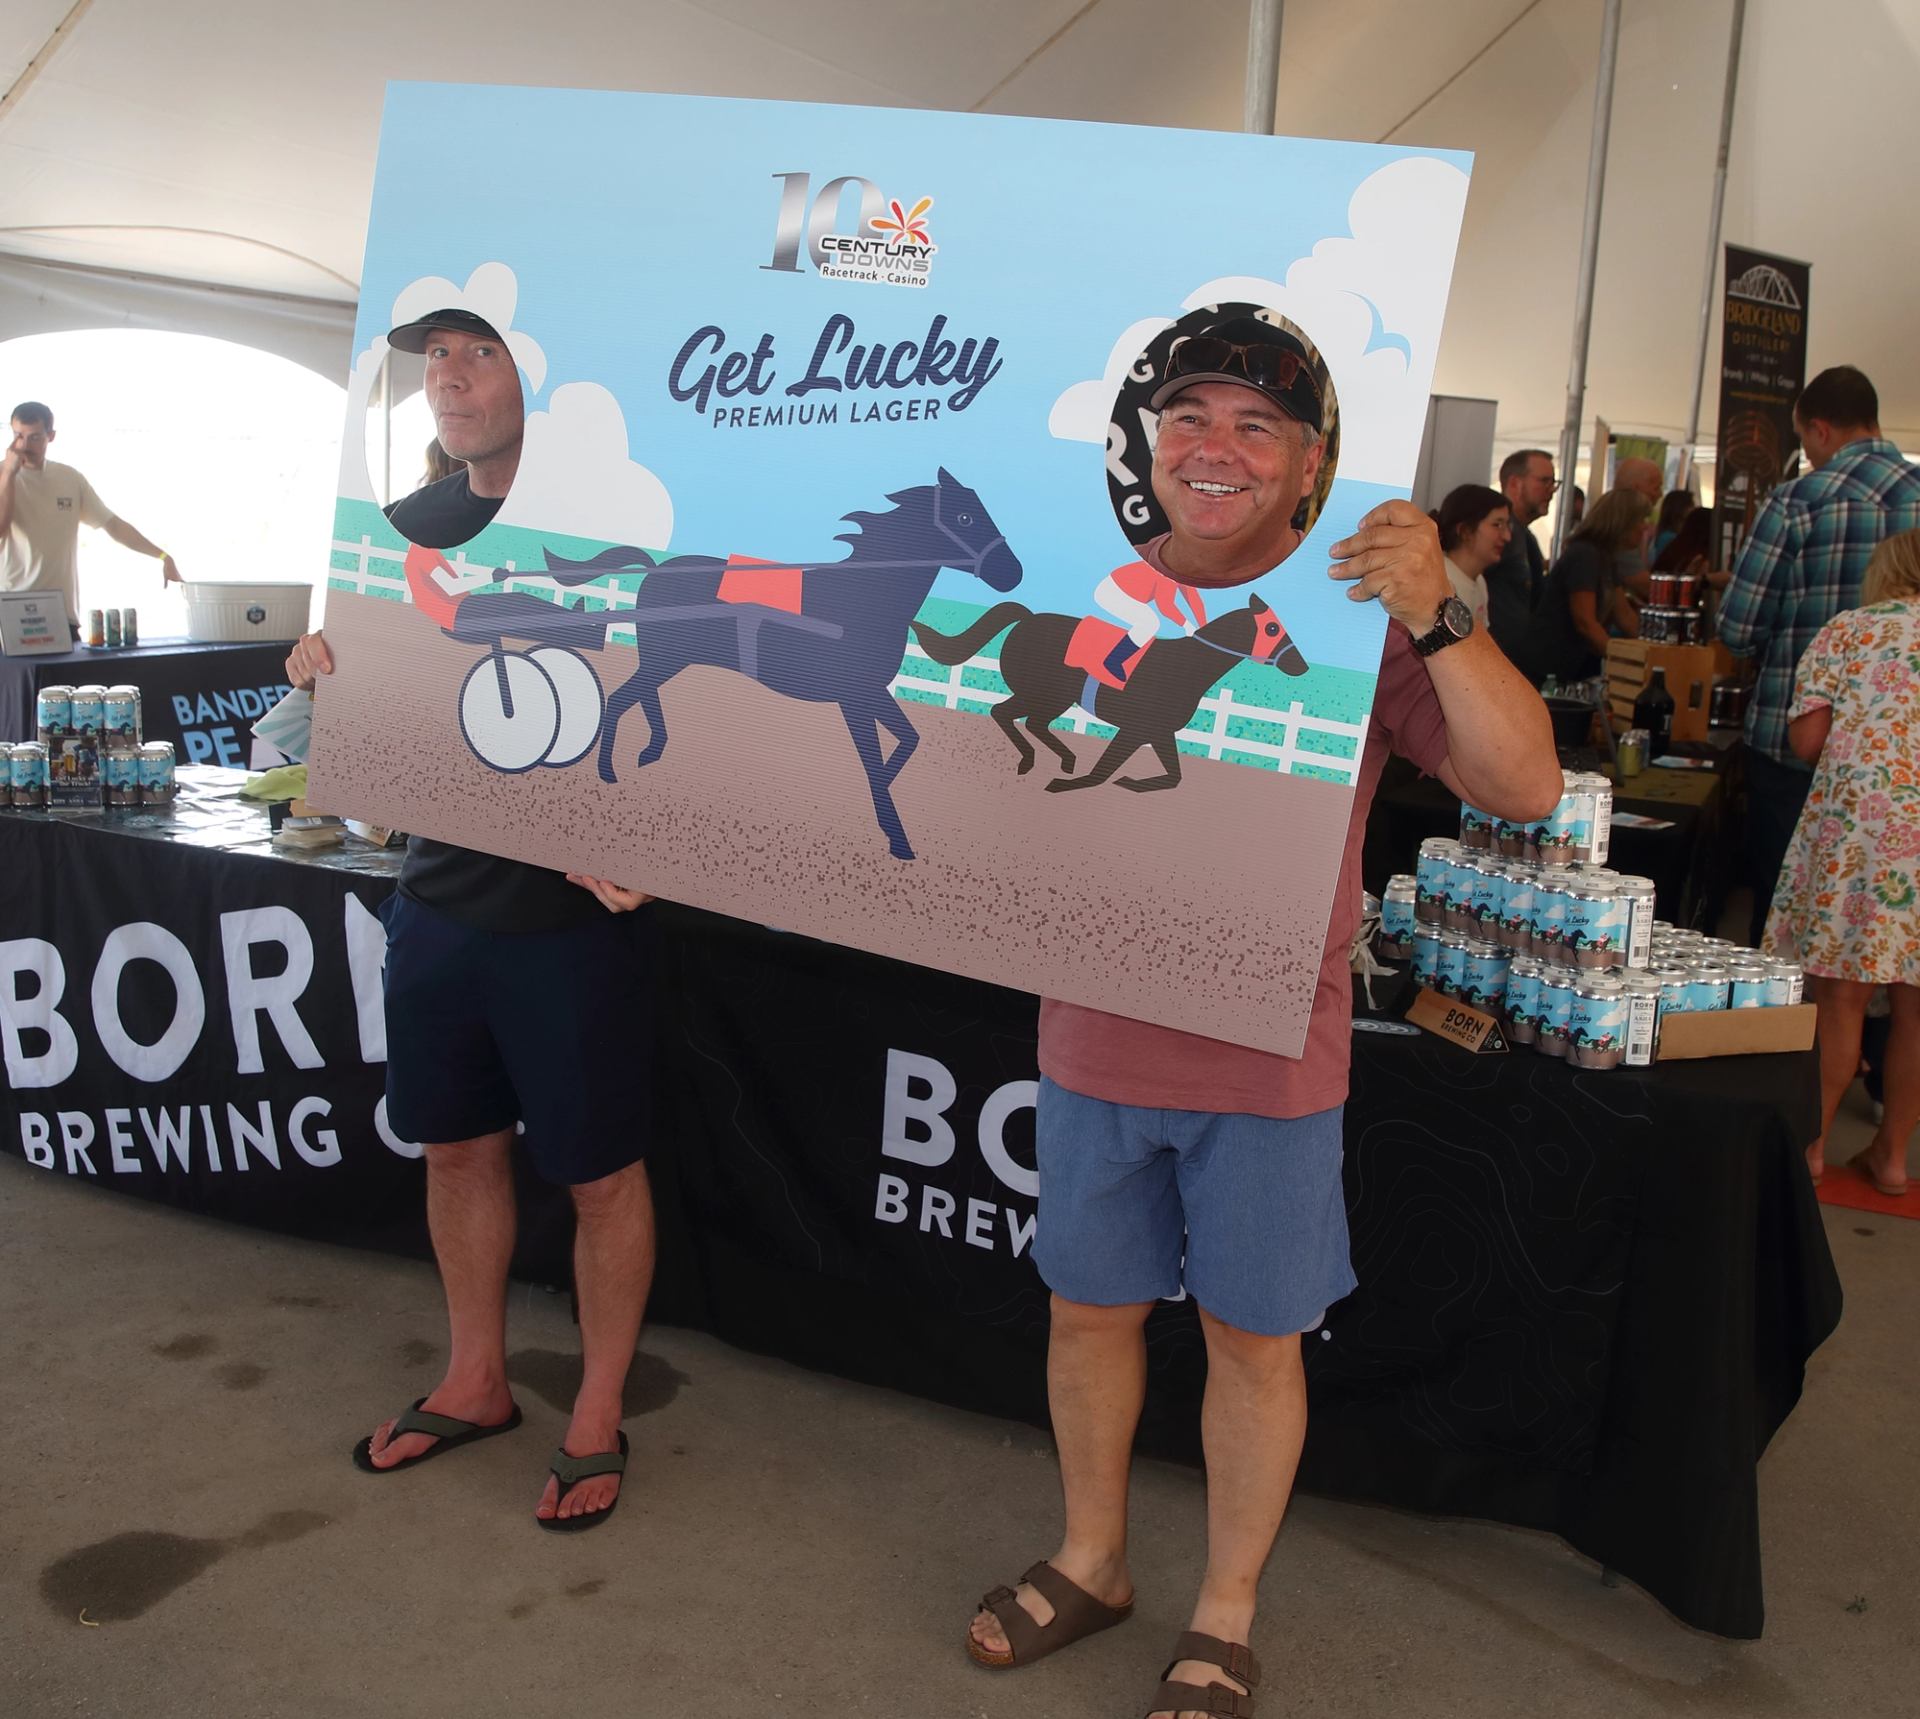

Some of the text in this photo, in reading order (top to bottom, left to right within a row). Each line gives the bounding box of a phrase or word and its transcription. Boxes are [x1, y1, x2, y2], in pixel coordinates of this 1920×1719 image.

[821, 236, 932, 260] CENTURY
[839, 251, 929, 273] DOWNS
[821, 265, 926, 286] Racetrack Casino
[668, 312, 1003, 414] Get Lucky
[712, 398, 941, 429] PREMIUM LAGER
[1440, 1022, 1467, 1040] BREWING
[1445, 1007, 1485, 1036] BORN
[20, 1096, 342, 1175] BREWING
